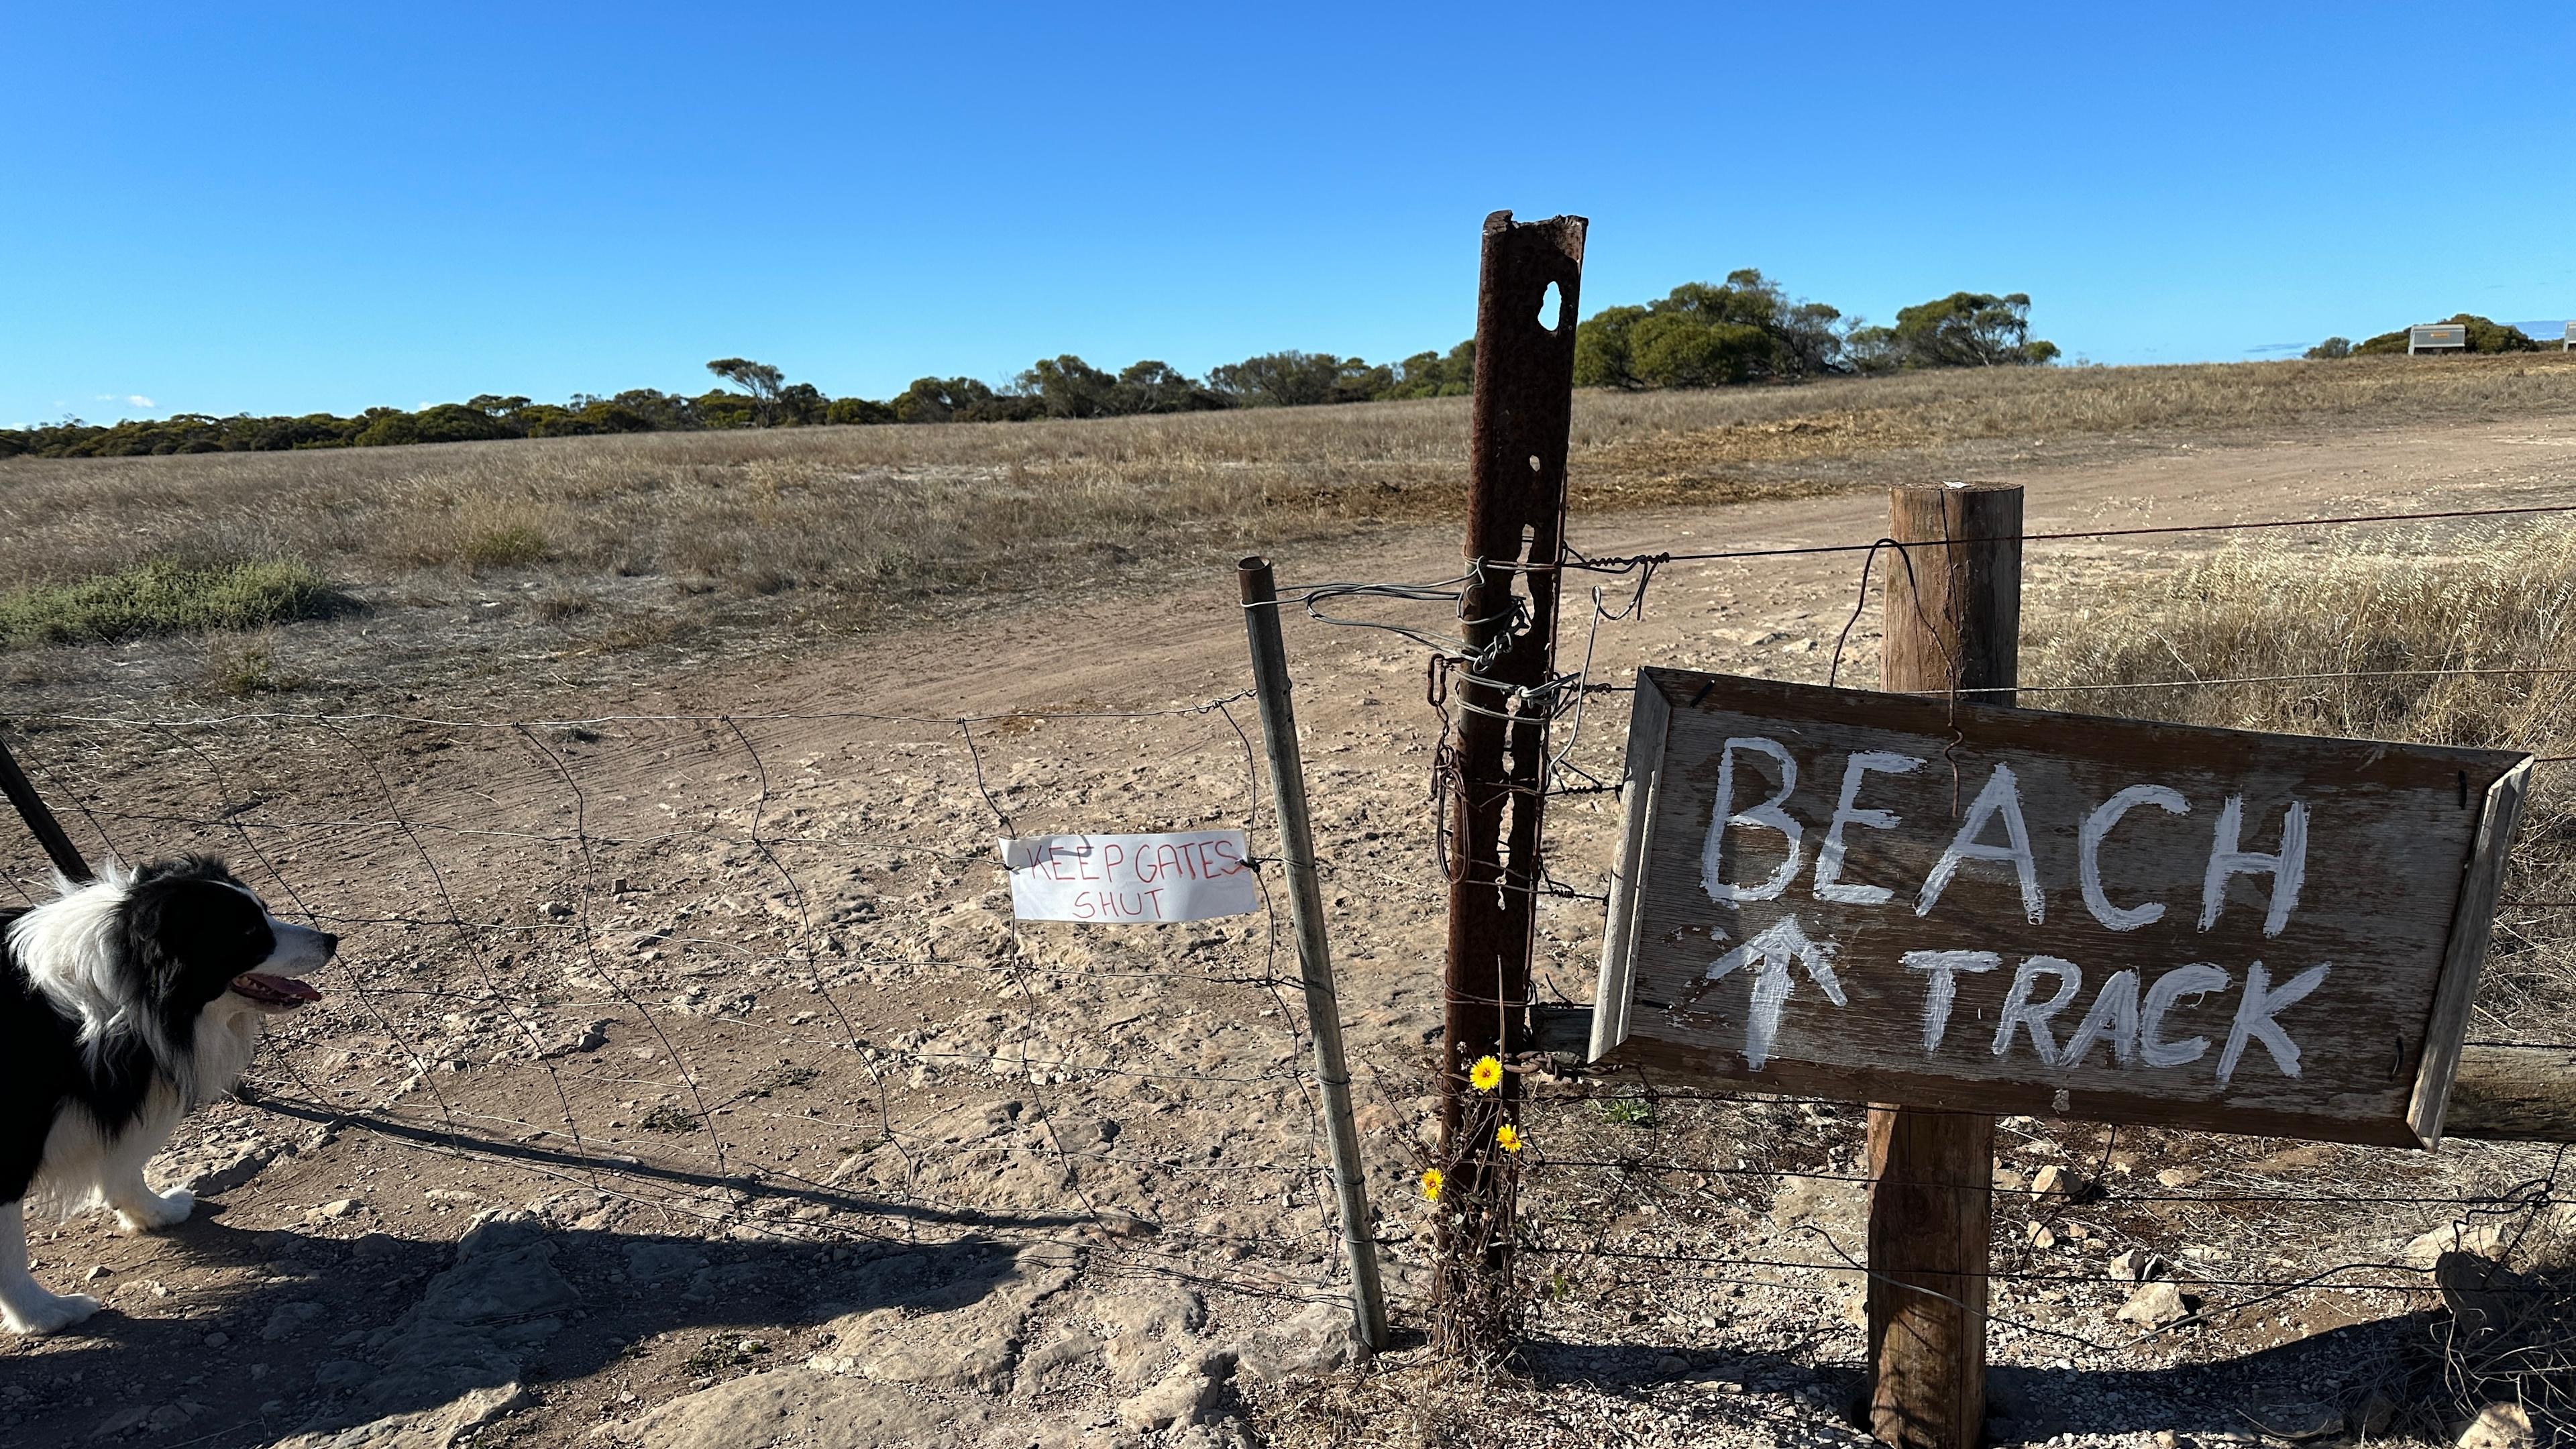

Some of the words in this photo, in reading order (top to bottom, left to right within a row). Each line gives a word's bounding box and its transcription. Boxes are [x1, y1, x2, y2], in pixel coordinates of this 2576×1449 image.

[1026, 843, 1124, 883] KEEP
[1135, 841, 1244, 883] GATES
[1700, 736, 2311, 938] BEACH
[1073, 888, 1164, 919] SHUT
[1900, 949, 2333, 1089] TRACK
